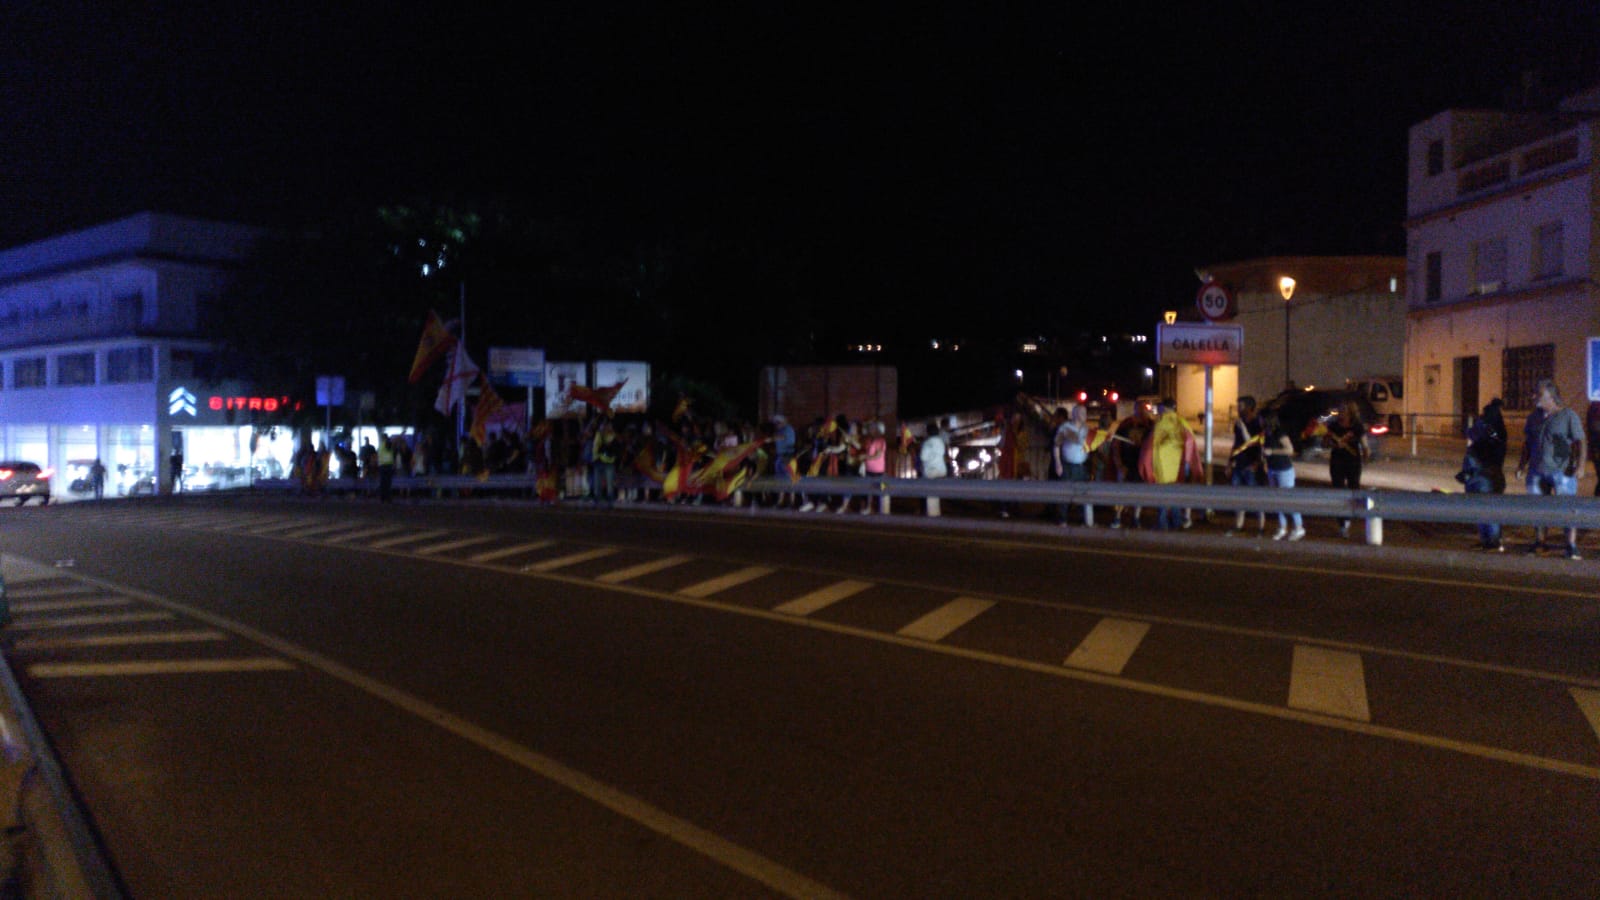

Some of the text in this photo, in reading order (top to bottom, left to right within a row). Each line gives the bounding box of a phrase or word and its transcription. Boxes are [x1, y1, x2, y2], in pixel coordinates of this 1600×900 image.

[1205, 295, 1225, 309] 50
[1172, 338, 1230, 351] CALELLA
[207, 395, 303, 412] CITRO
